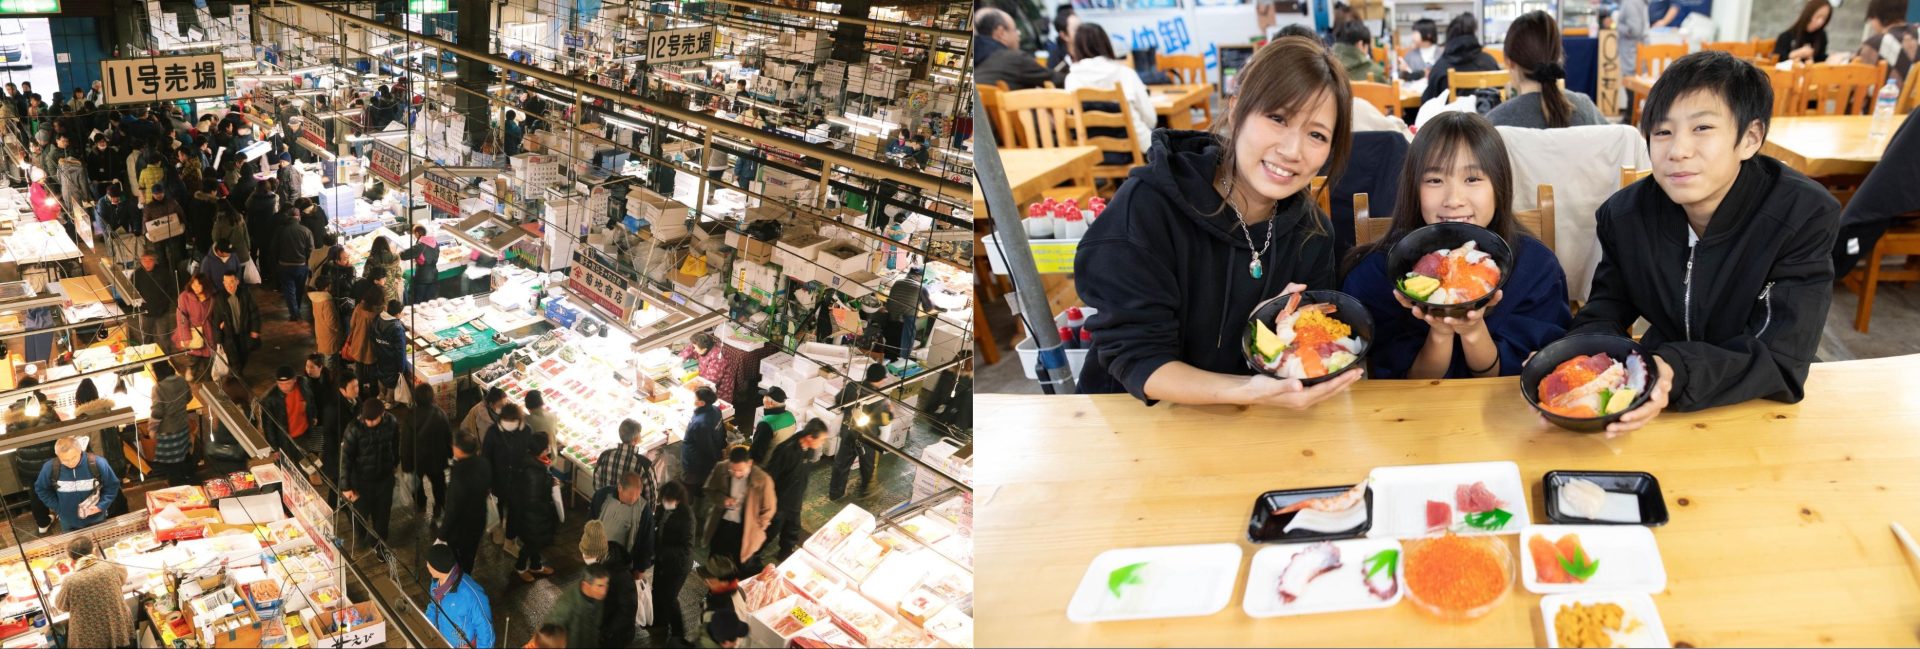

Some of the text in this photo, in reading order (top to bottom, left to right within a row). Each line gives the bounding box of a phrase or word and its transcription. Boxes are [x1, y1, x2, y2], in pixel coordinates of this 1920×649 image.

[650, 31, 712, 59] 12号売場
[109, 61, 217, 97] 11号売場
[1601, 32, 1618, 114] OPEN
